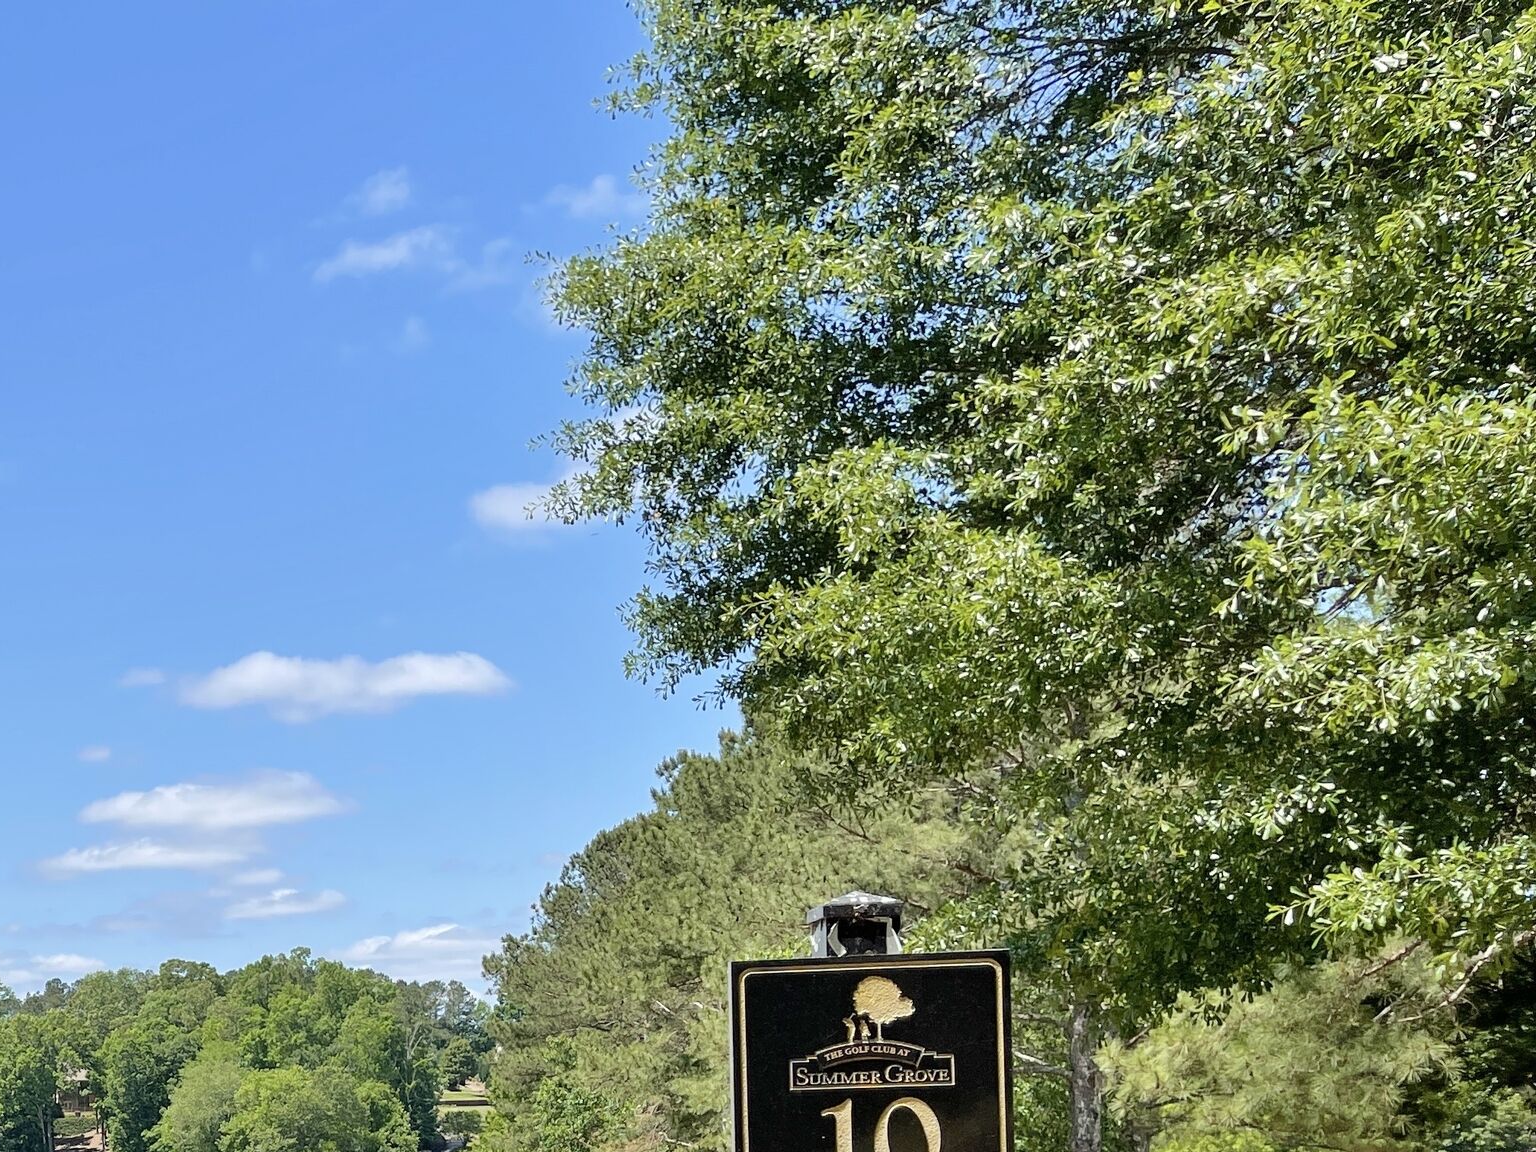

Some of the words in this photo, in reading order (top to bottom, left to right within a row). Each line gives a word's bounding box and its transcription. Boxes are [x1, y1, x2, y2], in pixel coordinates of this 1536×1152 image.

[824, 1050, 844, 1062] THE
[845, 1045, 870, 1057] GOLF
[871, 1045, 896, 1056] CLUB
[897, 1049, 911, 1057] AT
[796, 1067, 883, 1086] SUMMER
[884, 1064, 950, 1083] GROVE
